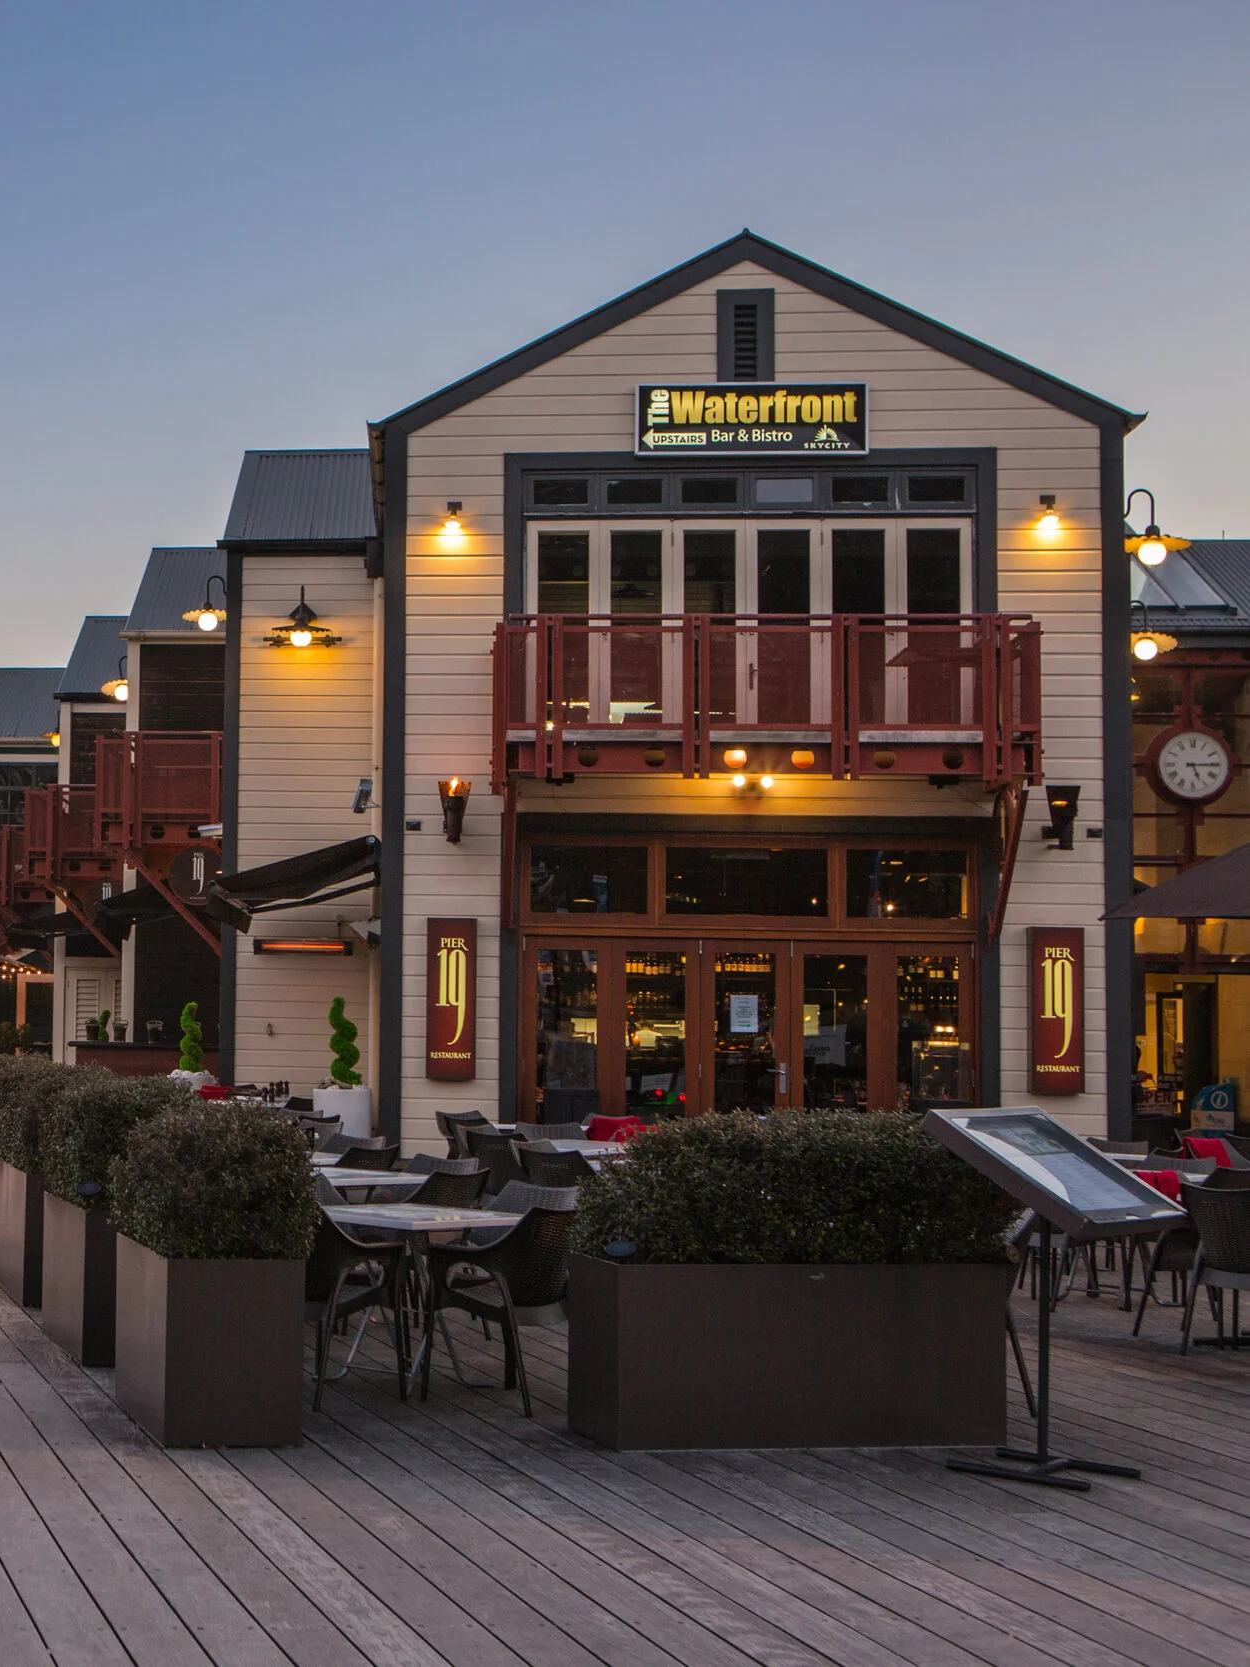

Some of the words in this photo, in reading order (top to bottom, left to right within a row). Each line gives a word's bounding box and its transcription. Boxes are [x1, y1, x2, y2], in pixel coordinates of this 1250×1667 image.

[670, 390, 858, 425] Waterfront
[652, 434, 705, 444] UPSTAIRS
[711, 429, 734, 442] Bar
[737, 429, 749, 442] &
[751, 429, 793, 442] Bistro
[440, 937, 469, 951] PIER
[1044, 947, 1075, 962] PIER
[435, 948, 467, 1046] 19
[1040, 958, 1073, 1058] 19
[430, 1051, 472, 1060] RESTAURANT
[1036, 1064, 1080, 1073] RESTAURANT
